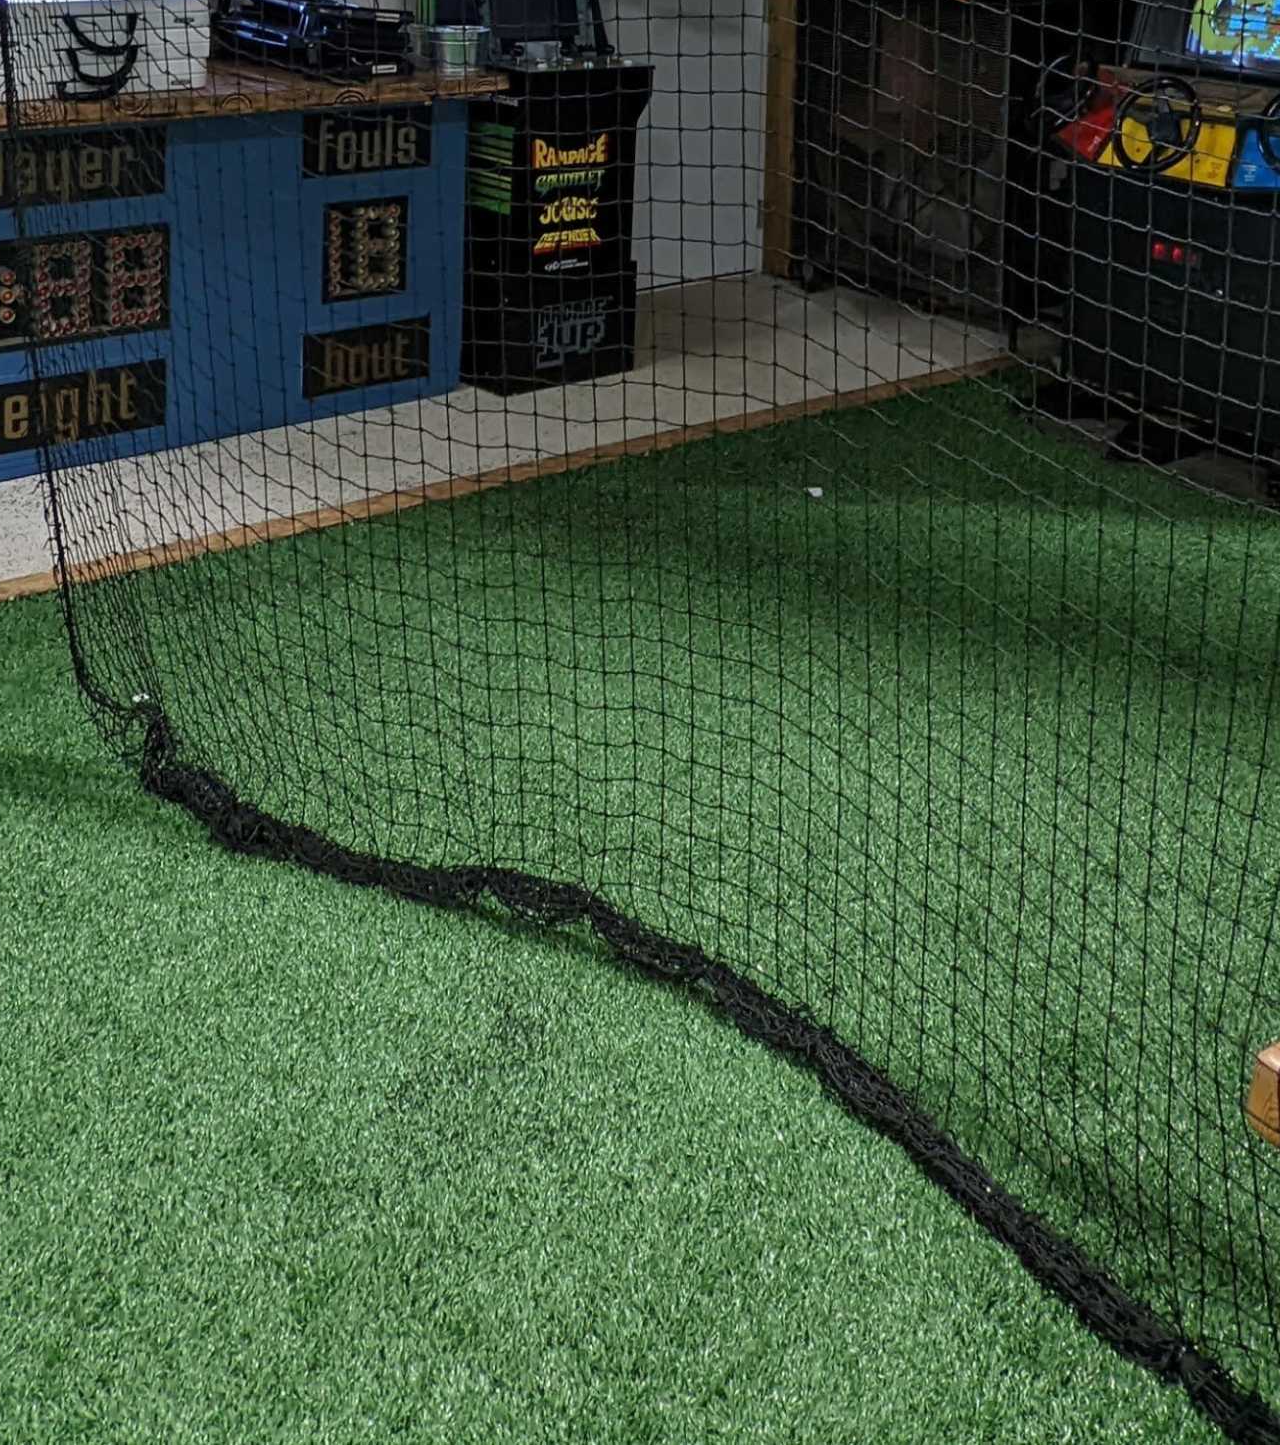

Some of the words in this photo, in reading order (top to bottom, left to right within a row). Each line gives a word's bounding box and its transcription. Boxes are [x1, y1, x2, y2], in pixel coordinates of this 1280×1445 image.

[320, 114, 418, 174] fouls
[532, 133, 608, 169] RAMPAGE
[325, 331, 412, 389] bout
